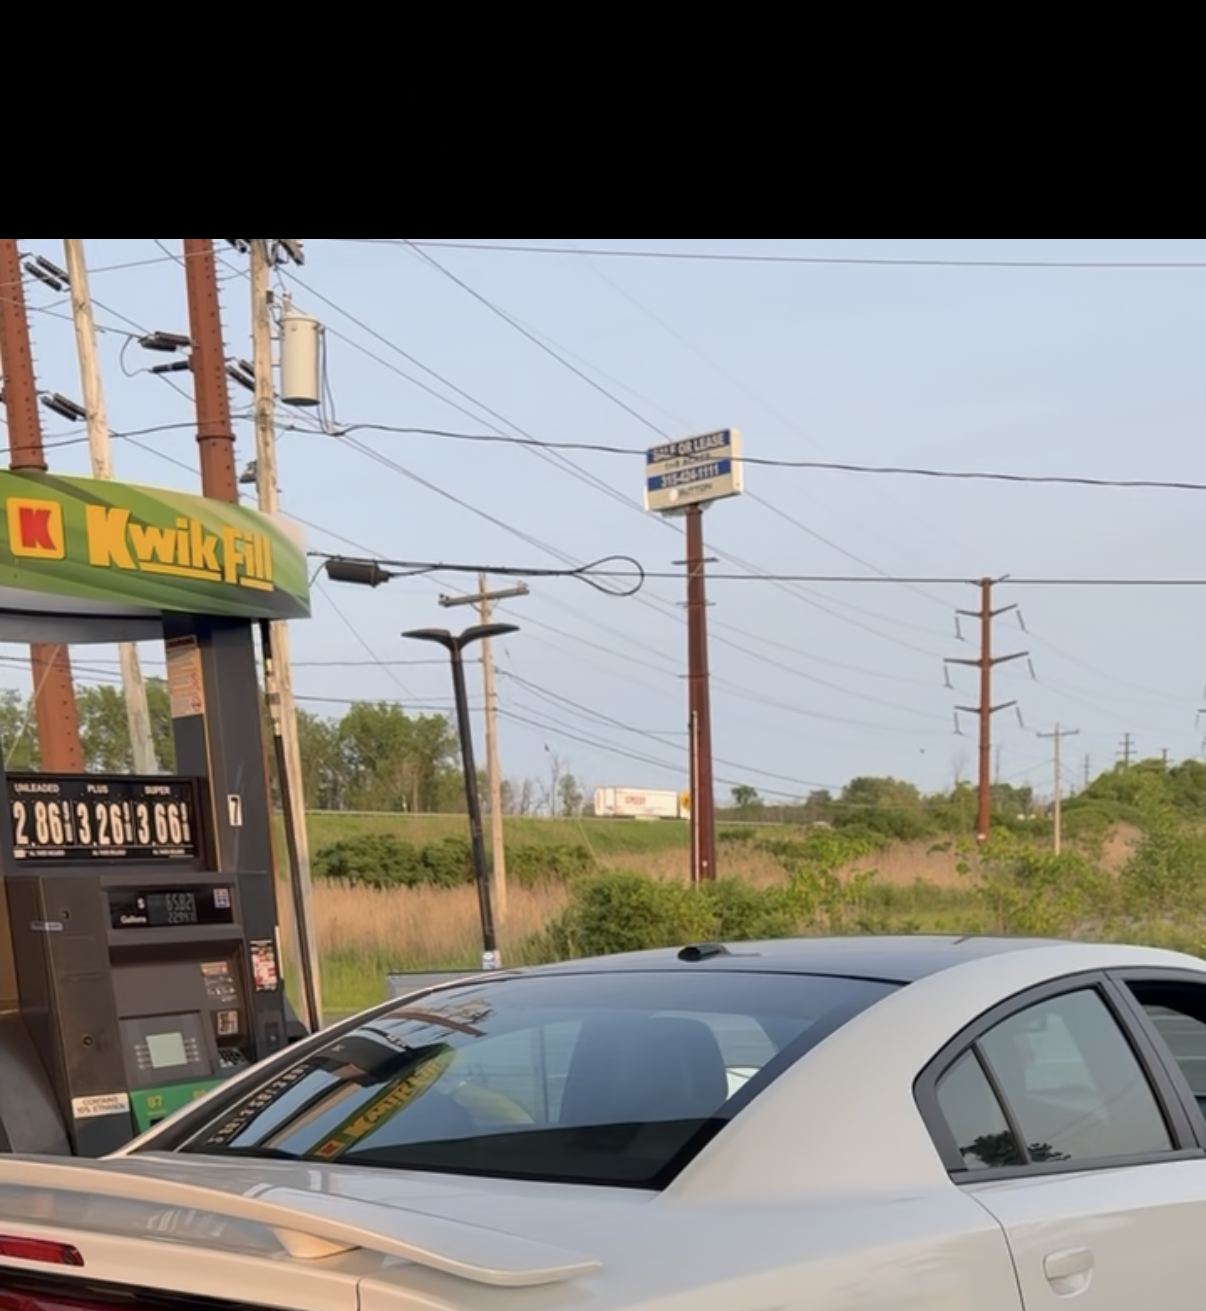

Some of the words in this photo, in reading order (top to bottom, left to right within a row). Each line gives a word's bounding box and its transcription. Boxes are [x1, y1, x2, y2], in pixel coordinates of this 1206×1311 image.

[678, 440, 693, 455] OR
[694, 432, 725, 451] LEASE
[19, 507, 56, 550] K
[85, 504, 221, 572] Kwik
[221, 525, 273, 586] Fill
[14, 783, 60, 794] UNLEADED
[87, 785, 109, 795] PLUS
[144, 785, 171, 796] SUPER
[230, 797, 239, 825] 7
[137, 897, 145, 909] $
[120, 914, 147, 924] Gallons
[147, 1095, 163, 1108] 87
